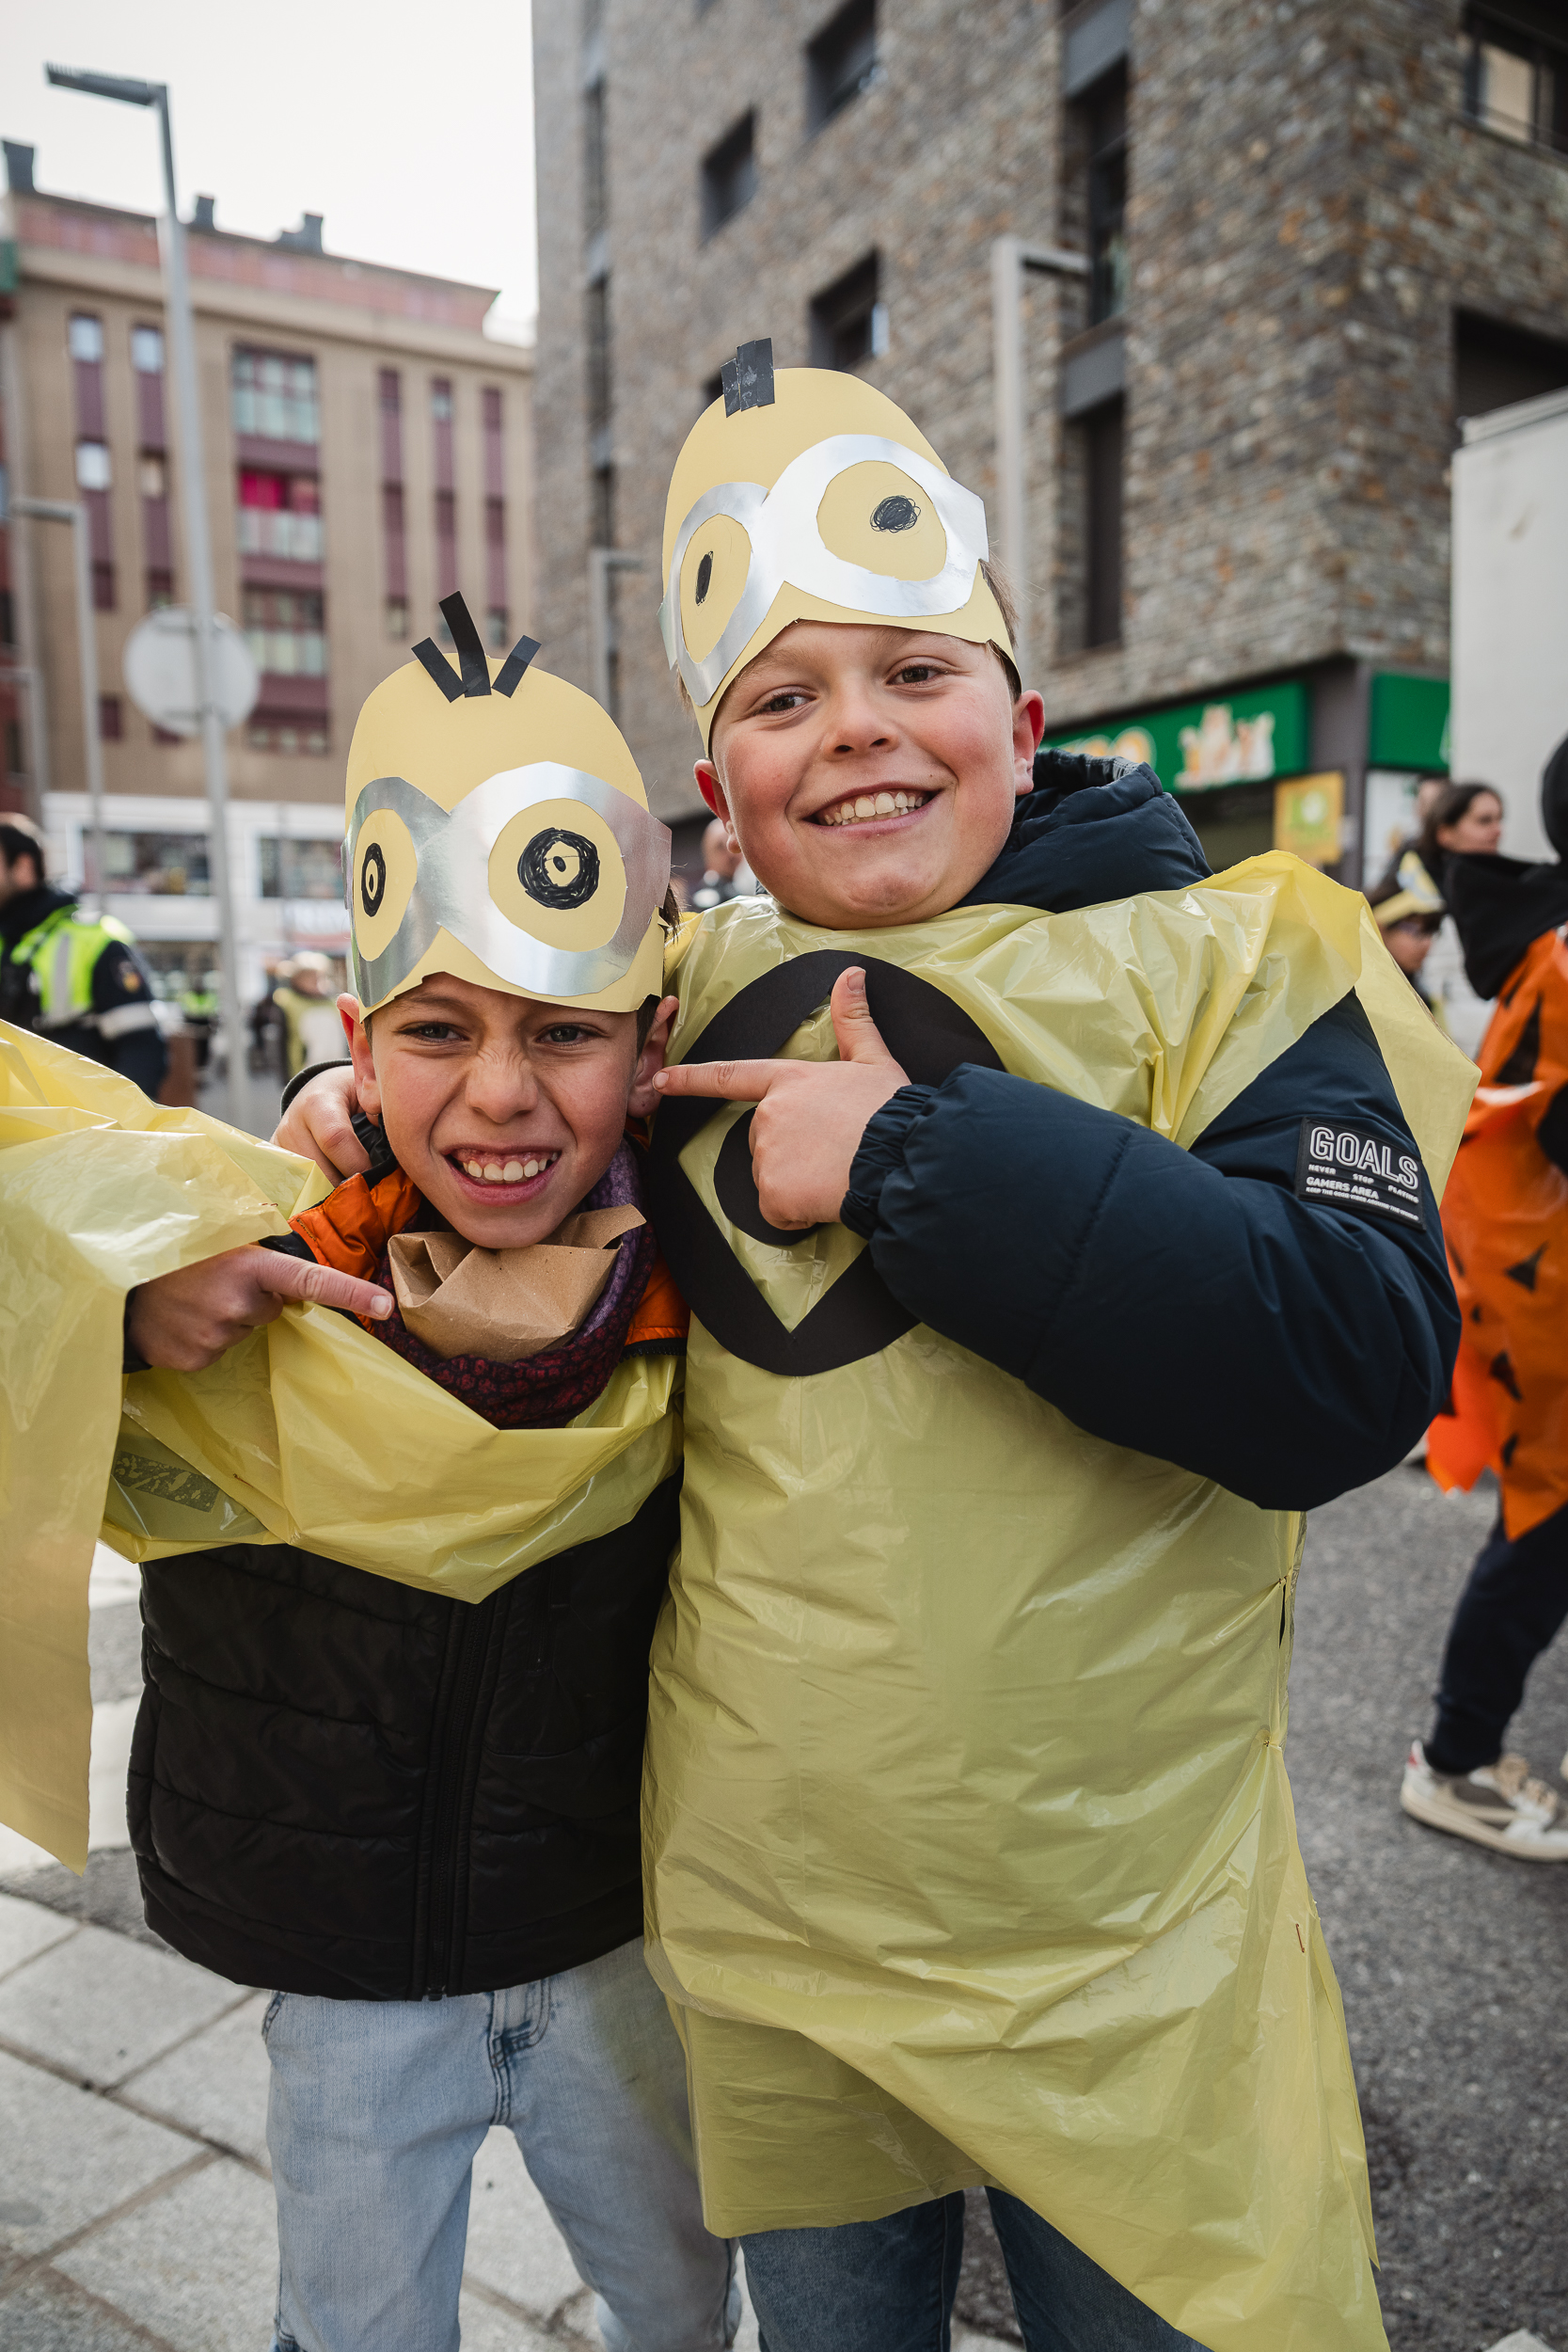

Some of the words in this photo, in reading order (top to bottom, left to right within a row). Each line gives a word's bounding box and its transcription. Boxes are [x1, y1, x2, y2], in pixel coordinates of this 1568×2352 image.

[1309, 1126, 1418, 1190] GOALS
[1306, 1176, 1351, 1192] GAMERS
[1351, 1184, 1380, 1200] AREA
[1308, 1164, 1337, 1175] NEVER
[1353, 1173, 1374, 1184] STOP
[1387, 1184, 1419, 1204] PLAYING
